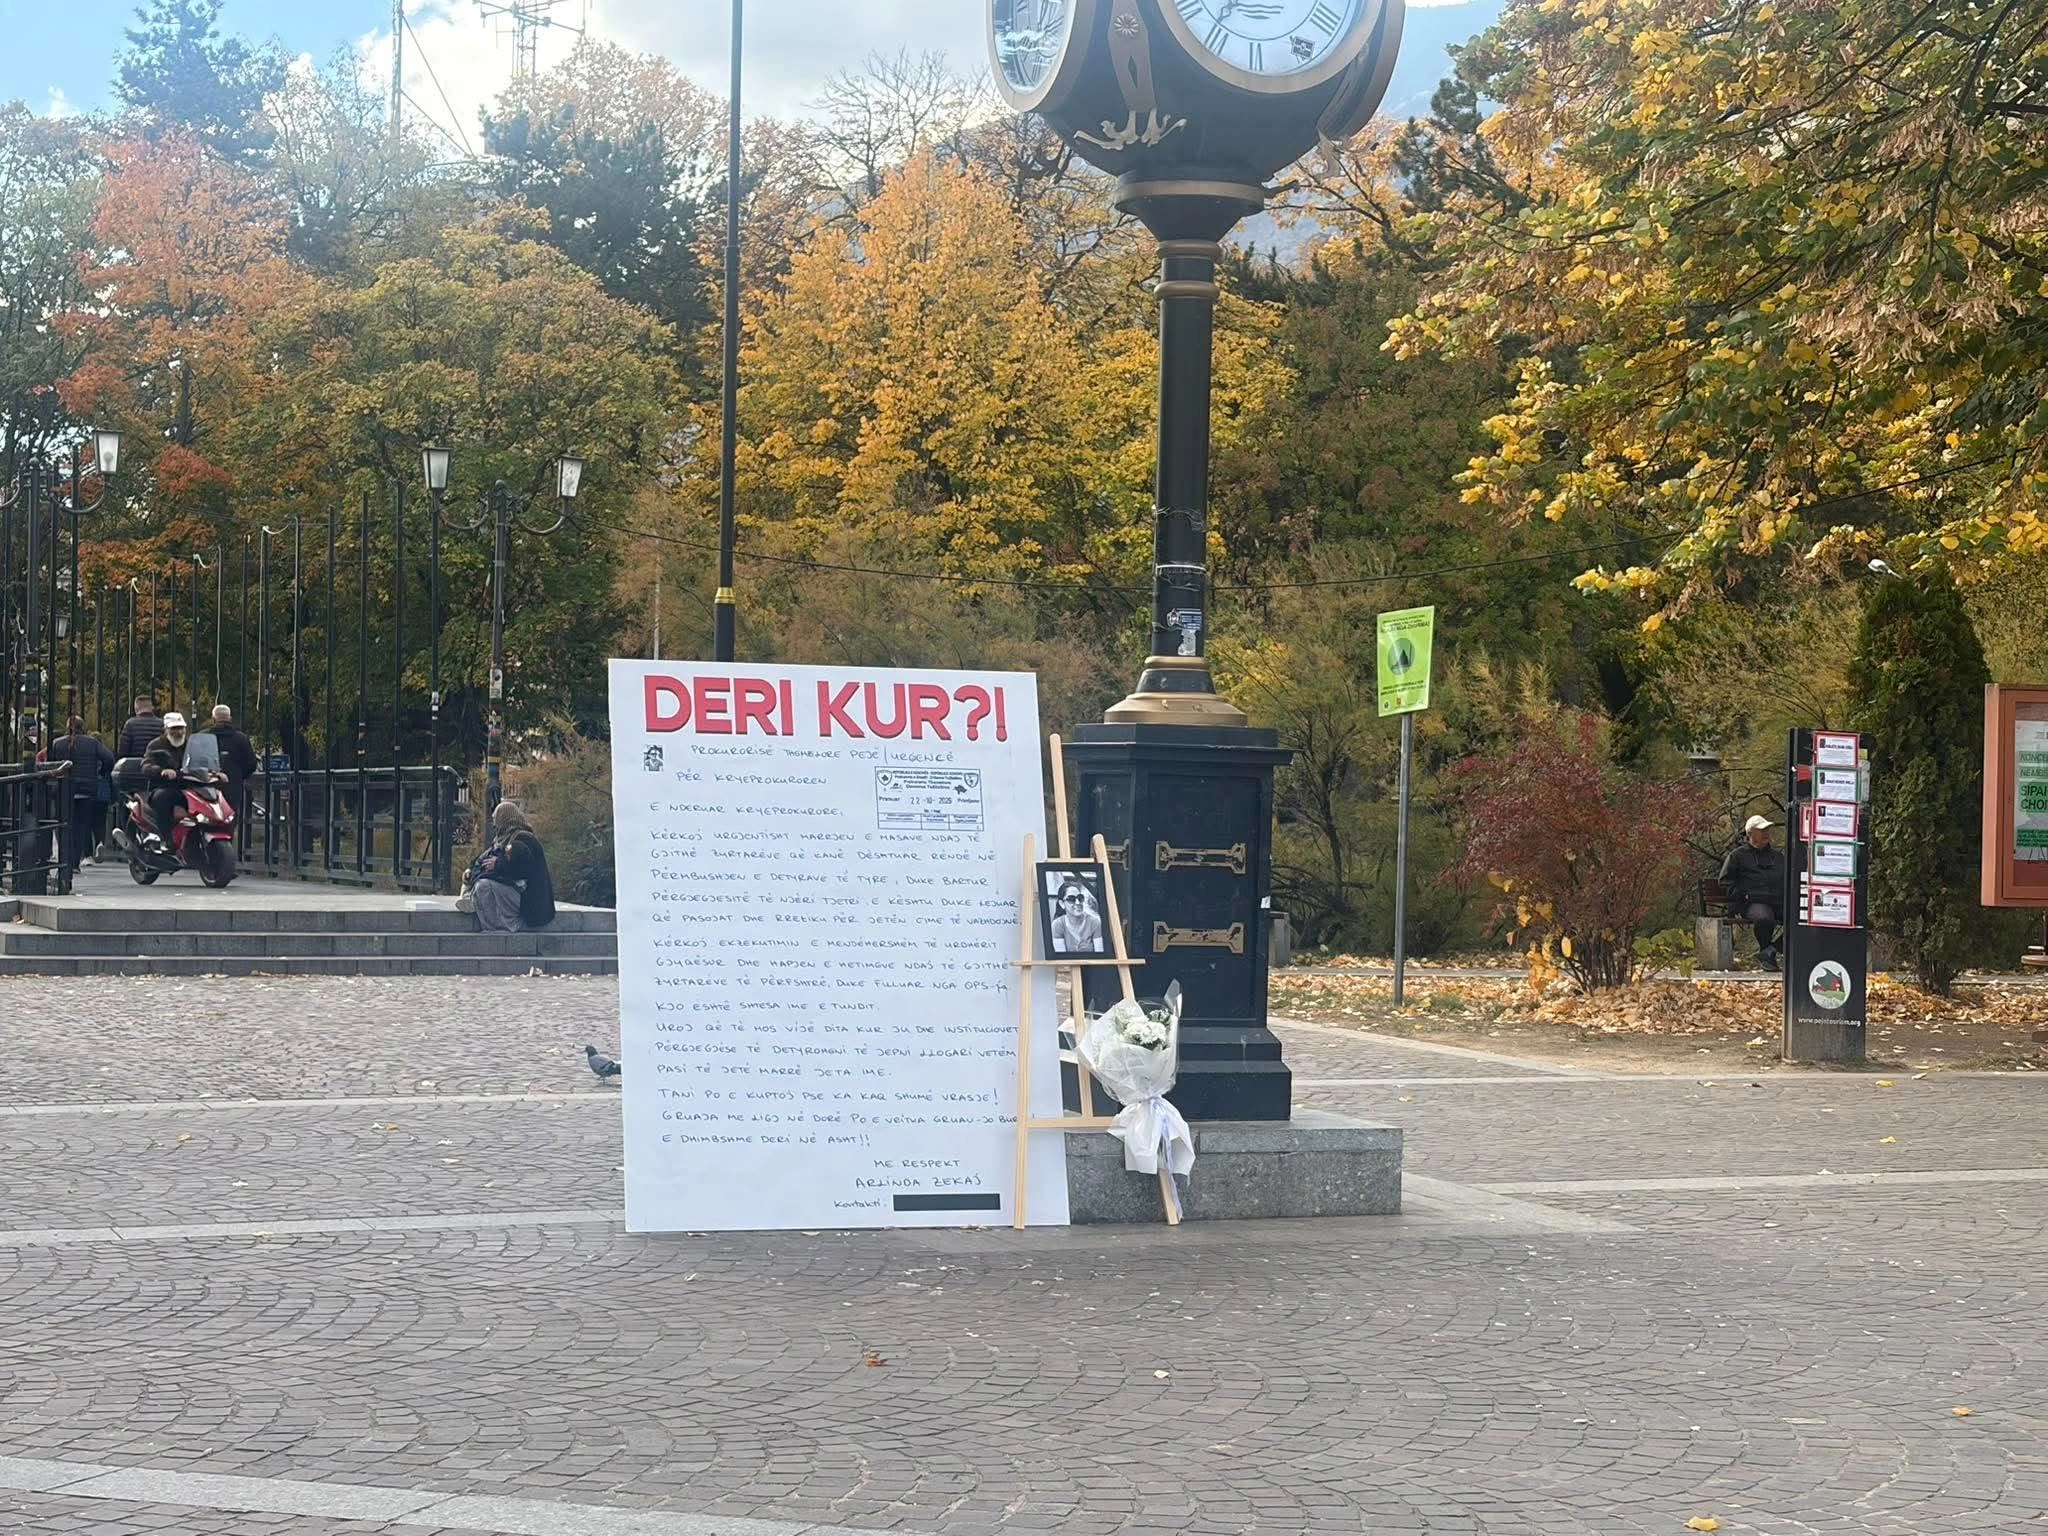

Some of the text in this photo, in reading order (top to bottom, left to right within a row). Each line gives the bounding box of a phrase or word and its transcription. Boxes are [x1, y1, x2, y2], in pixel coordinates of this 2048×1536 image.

[644, 675, 1008, 742] DERI KUR?!
[677, 768, 827, 785] PËR KRYEPROKUROREN
[650, 802, 659, 811] E
[669, 804, 726, 814] NDERUAR
[650, 828, 703, 840] KËRKOJ
[800, 832, 854, 841] MARRJEN
[880, 833, 923, 842] MASAVE
[931, 834, 961, 842] NDAJ
[967, 832, 981, 843] TË
[651, 847, 697, 859] GJITHË
[814, 848, 848, 860] KANË
[978, 850, 997, 861] NË
[650, 867, 746, 881] PËRMBUSHJEN
[770, 872, 828, 883] DETYRAVE
[836, 869, 849, 882] TË
[906, 876, 934, 885] DUKE
[942, 877, 990, 886] BARTUR
[758, 893, 774, 904] TË
[871, 898, 880, 906] E
[888, 895, 934, 906] KËSHTU
[941, 898, 973, 907] DUKE
[652, 910, 672, 922] QË
[682, 914, 734, 923] PASOJAT
[743, 914, 765, 922] DHE
[833, 912, 859, 924] PËR
[870, 913, 907, 924] JETËN
[653, 935, 708, 948] KËRKOJ
[719, 939, 800, 947] EKZEKUTIMIN
[810, 939, 818, 947] E
[925, 938, 937, 949] TË
[737, 959, 760, 967] DHE
[770, 959, 816, 968] HAPJEN
[824, 960, 831, 968] E
[904, 960, 934, 970] NDAJ
[941, 958, 955, 970] TË
[736, 974, 751, 986] TË
[836, 979, 865, 987] DUKE
[932, 981, 957, 989] NGA
[656, 1002, 685, 1011] KJO
[787, 1002, 808, 1010] IME
[819, 1002, 827, 1011] E
[656, 1022, 693, 1032] UROJ
[705, 1020, 722, 1032] QË
[730, 1020, 745, 1032] TË
[754, 1025, 777, 1033] MOS
[785, 1021, 815, 1033] VIJË
[824, 1023, 849, 1033] DITA
[856, 1025, 882, 1033] KUR
[892, 1025, 911, 1033] JU
[916, 1025, 935, 1033] DHE
[745, 1042, 761, 1053] TË
[854, 1043, 868, 1055] TË
[878, 1047, 911, 1057] JEPNI
[657, 1064, 687, 1074] PASI
[696, 1062, 711, 1074] TË
[721, 1062, 750, 1074] JETË
[759, 1065, 802, 1075] MARRË
[814, 1068, 851, 1077] JETA
[658, 1087, 695, 1098] TANI
[705, 1090, 721, 1099] PO
[728, 1091, 737, 1100] E
[746, 1090, 795, 1100] KUPTOJ
[802, 1091, 824, 1101] PSE
[833, 1092, 851, 1100] KA
[860, 1092, 887, 1101] KAQ
[895, 1089, 933, 1101] SHUMË
[727, 1114, 745, 1122] ME
[787, 1111, 804, 1122] NË
[813, 1112, 841, 1123] DORË
[850, 1113, 866, 1124] PO
[662, 1134, 672, 1143] E
[681, 1135, 753, 1144] DHIMBSHME
[761, 1134, 790, 1143] DERI
[799, 1132, 817, 1144] NË
[874, 1159, 961, 1168] ME RESPEKT
[855, 1173, 982, 1188] ARLINDA ZEKAJ
